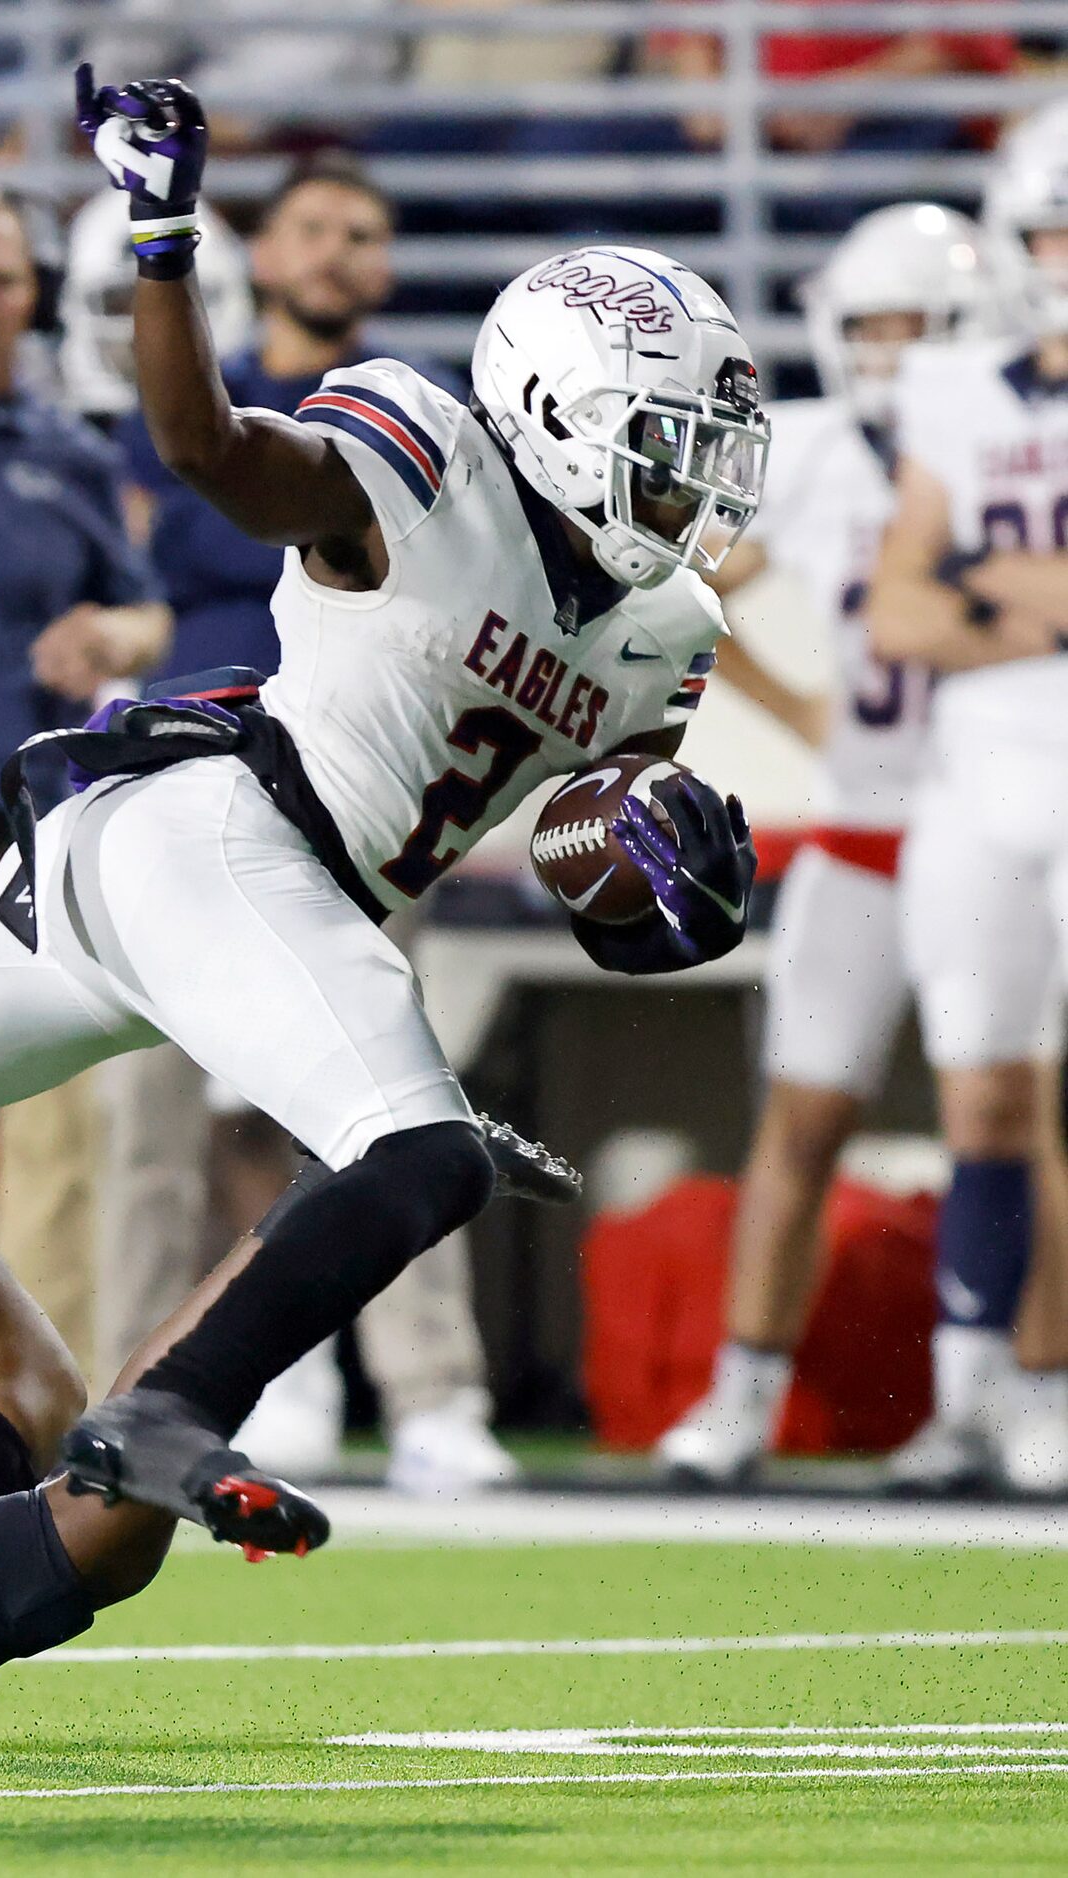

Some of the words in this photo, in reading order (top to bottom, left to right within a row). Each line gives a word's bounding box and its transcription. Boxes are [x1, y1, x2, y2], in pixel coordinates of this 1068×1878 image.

[528, 250, 674, 333] Eagles
[463, 608, 610, 748] EAGLES
[377, 705, 544, 900] 2
